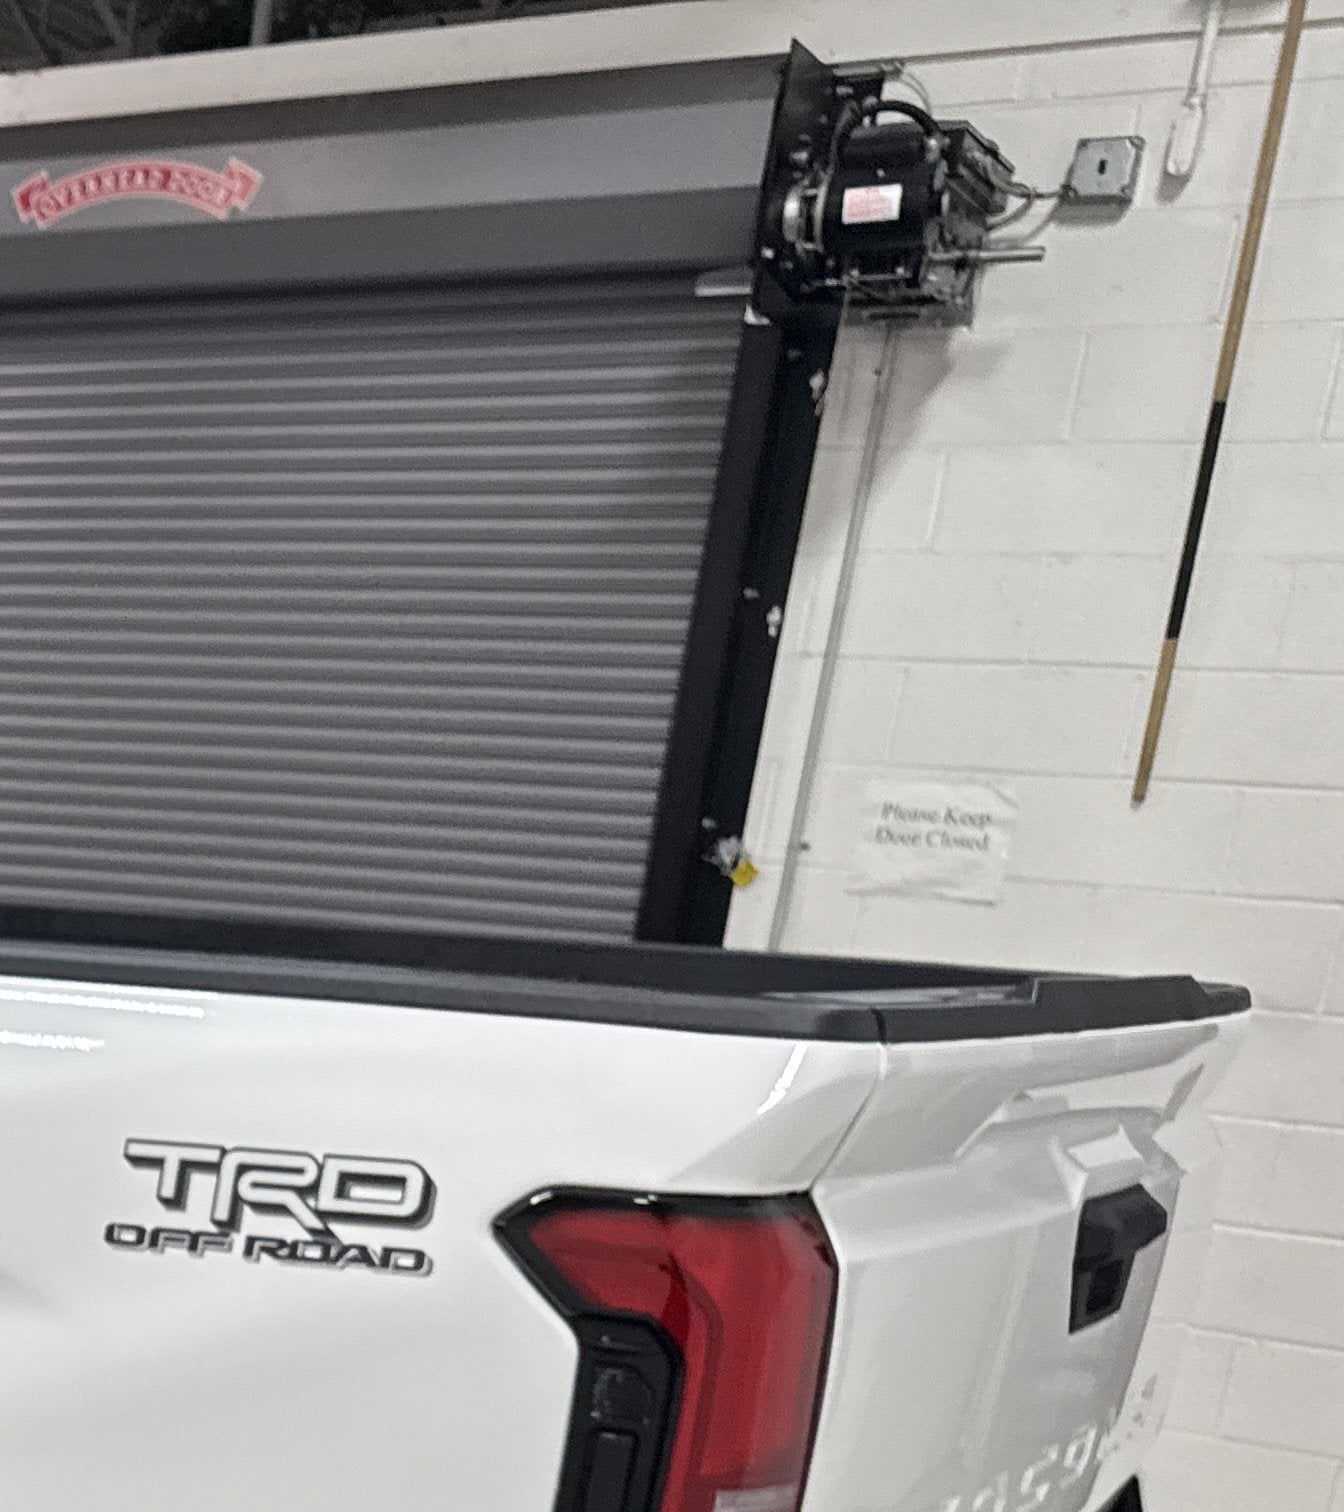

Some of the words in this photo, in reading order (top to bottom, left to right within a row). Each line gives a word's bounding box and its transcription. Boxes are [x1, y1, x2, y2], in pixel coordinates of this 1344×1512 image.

[881, 802, 940, 823] Please
[943, 806, 992, 830] Keep
[875, 825, 922, 846] Door
[925, 829, 990, 851] Closed
[123, 1137, 436, 1231] TRD
[104, 1221, 233, 1256] OFF
[242, 1234, 433, 1277] ROAD
